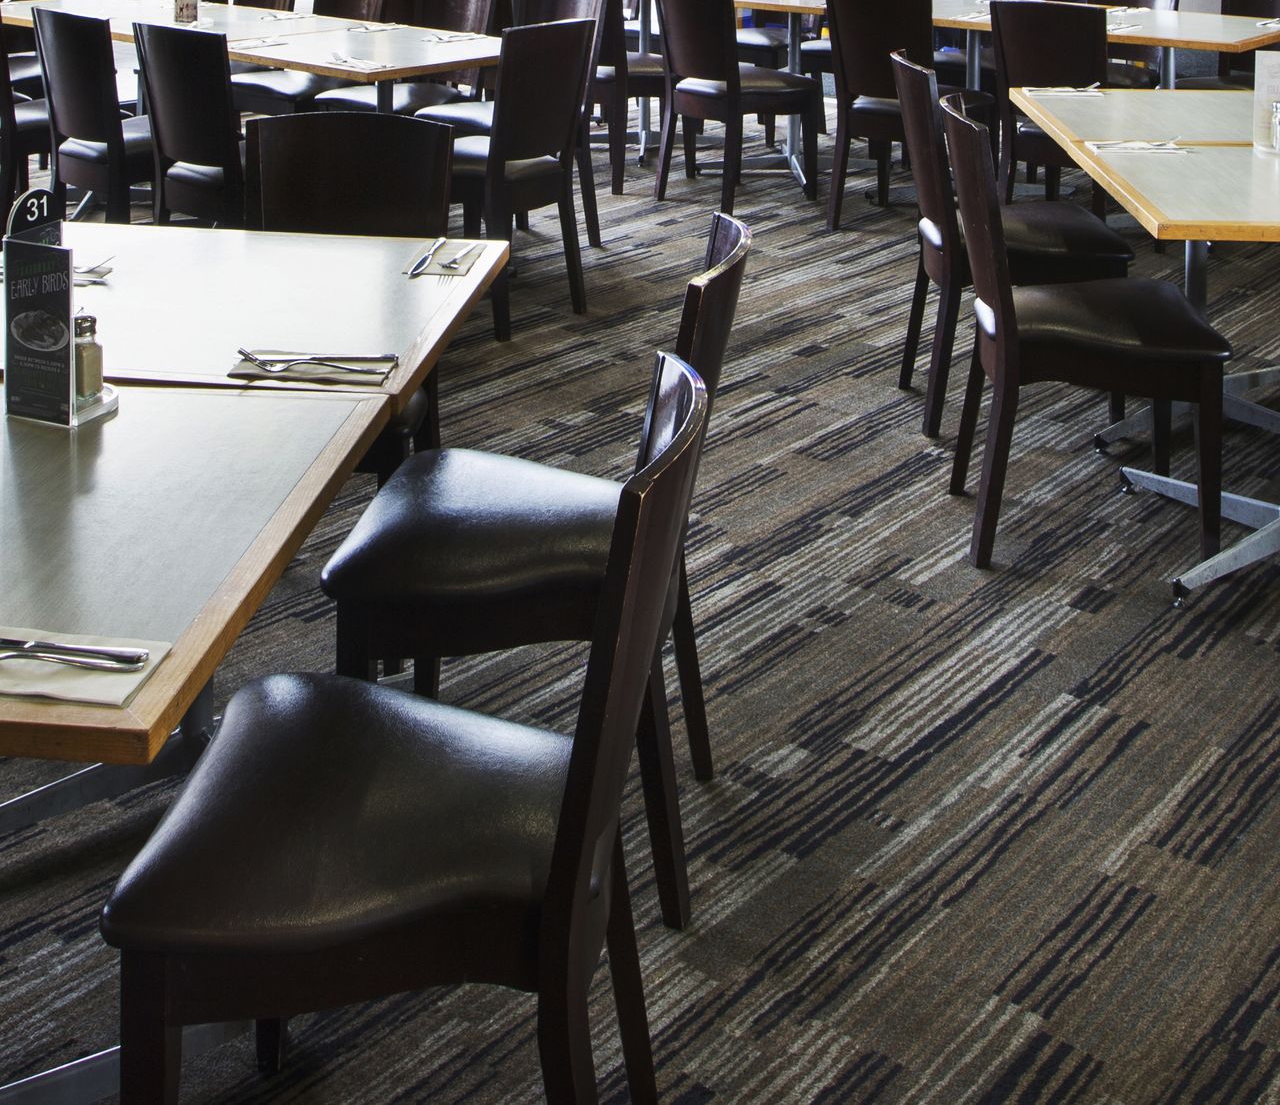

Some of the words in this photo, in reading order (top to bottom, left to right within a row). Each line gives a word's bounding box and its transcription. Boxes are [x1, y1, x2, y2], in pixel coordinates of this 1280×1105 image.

[26, 194, 48, 222] 31
[10, 273, 41, 300] EARLY
[42, 270, 70, 294] BIRDS
